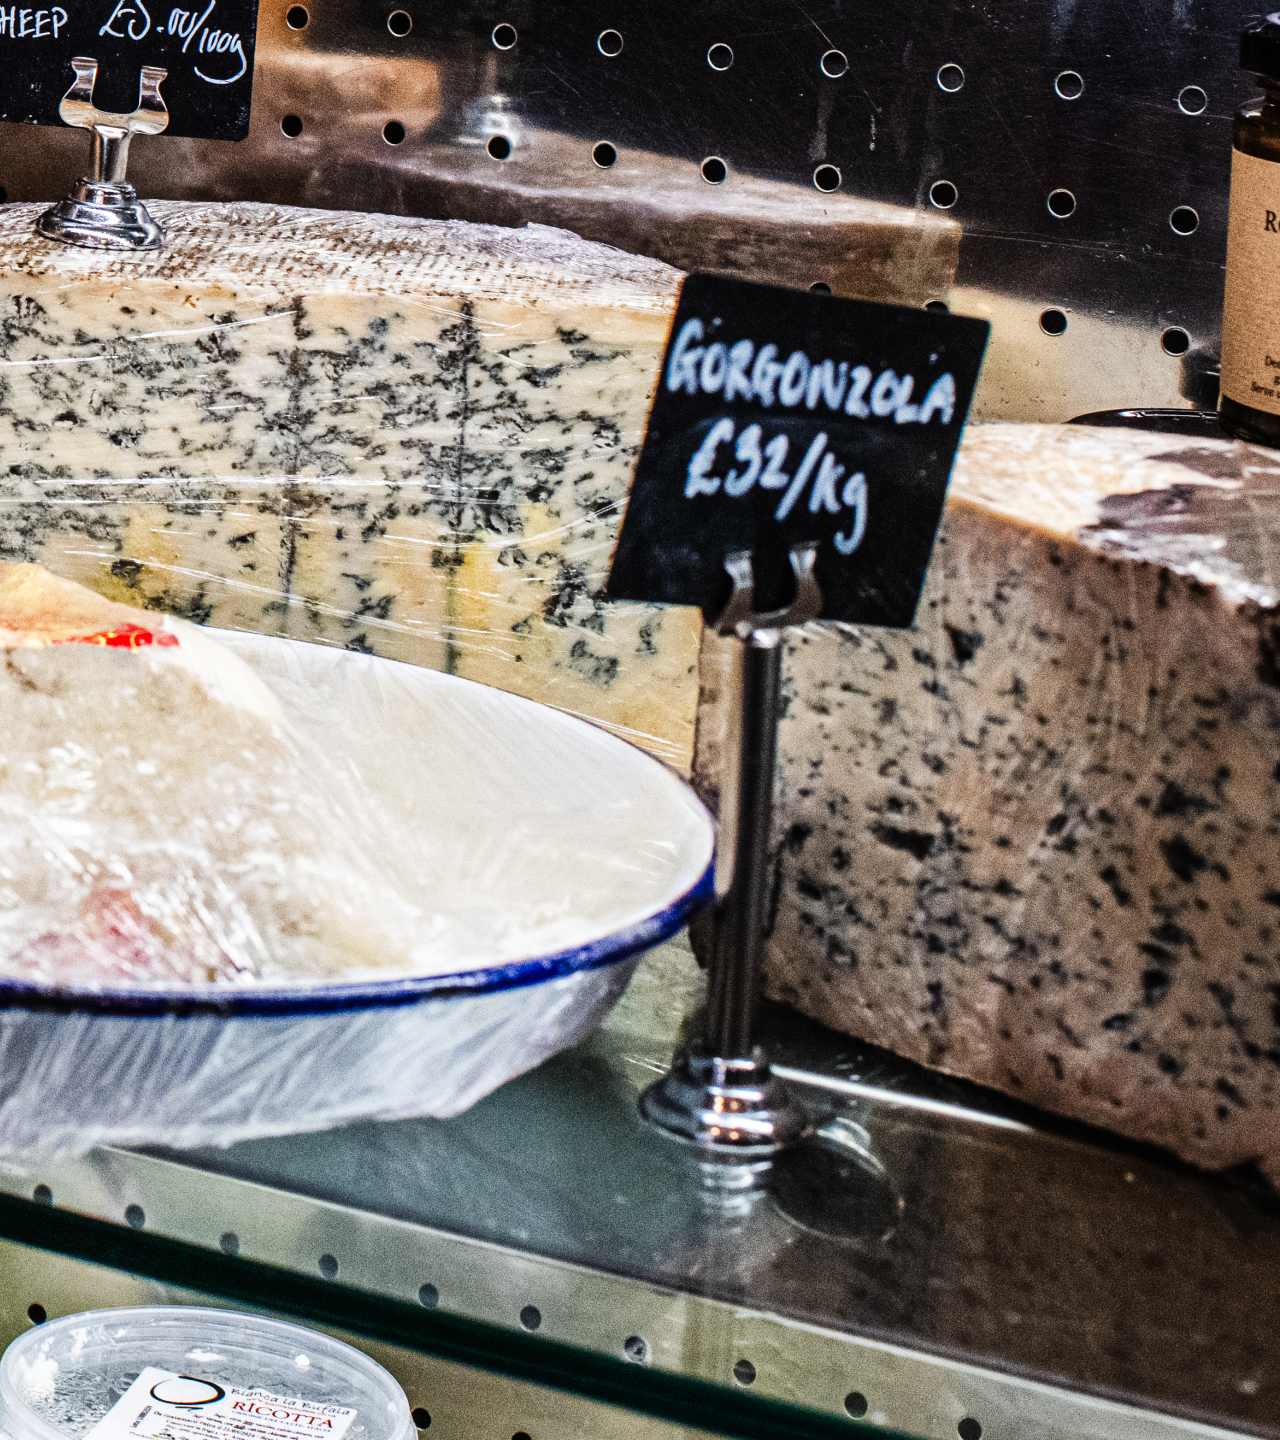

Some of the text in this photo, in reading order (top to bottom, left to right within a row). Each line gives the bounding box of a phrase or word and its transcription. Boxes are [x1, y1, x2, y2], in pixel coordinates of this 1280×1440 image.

[1264, 209, 1280, 233] R
[666, 317, 958, 426] GORGONZOLA
[232, 1401, 334, 1429] RICOTTA
